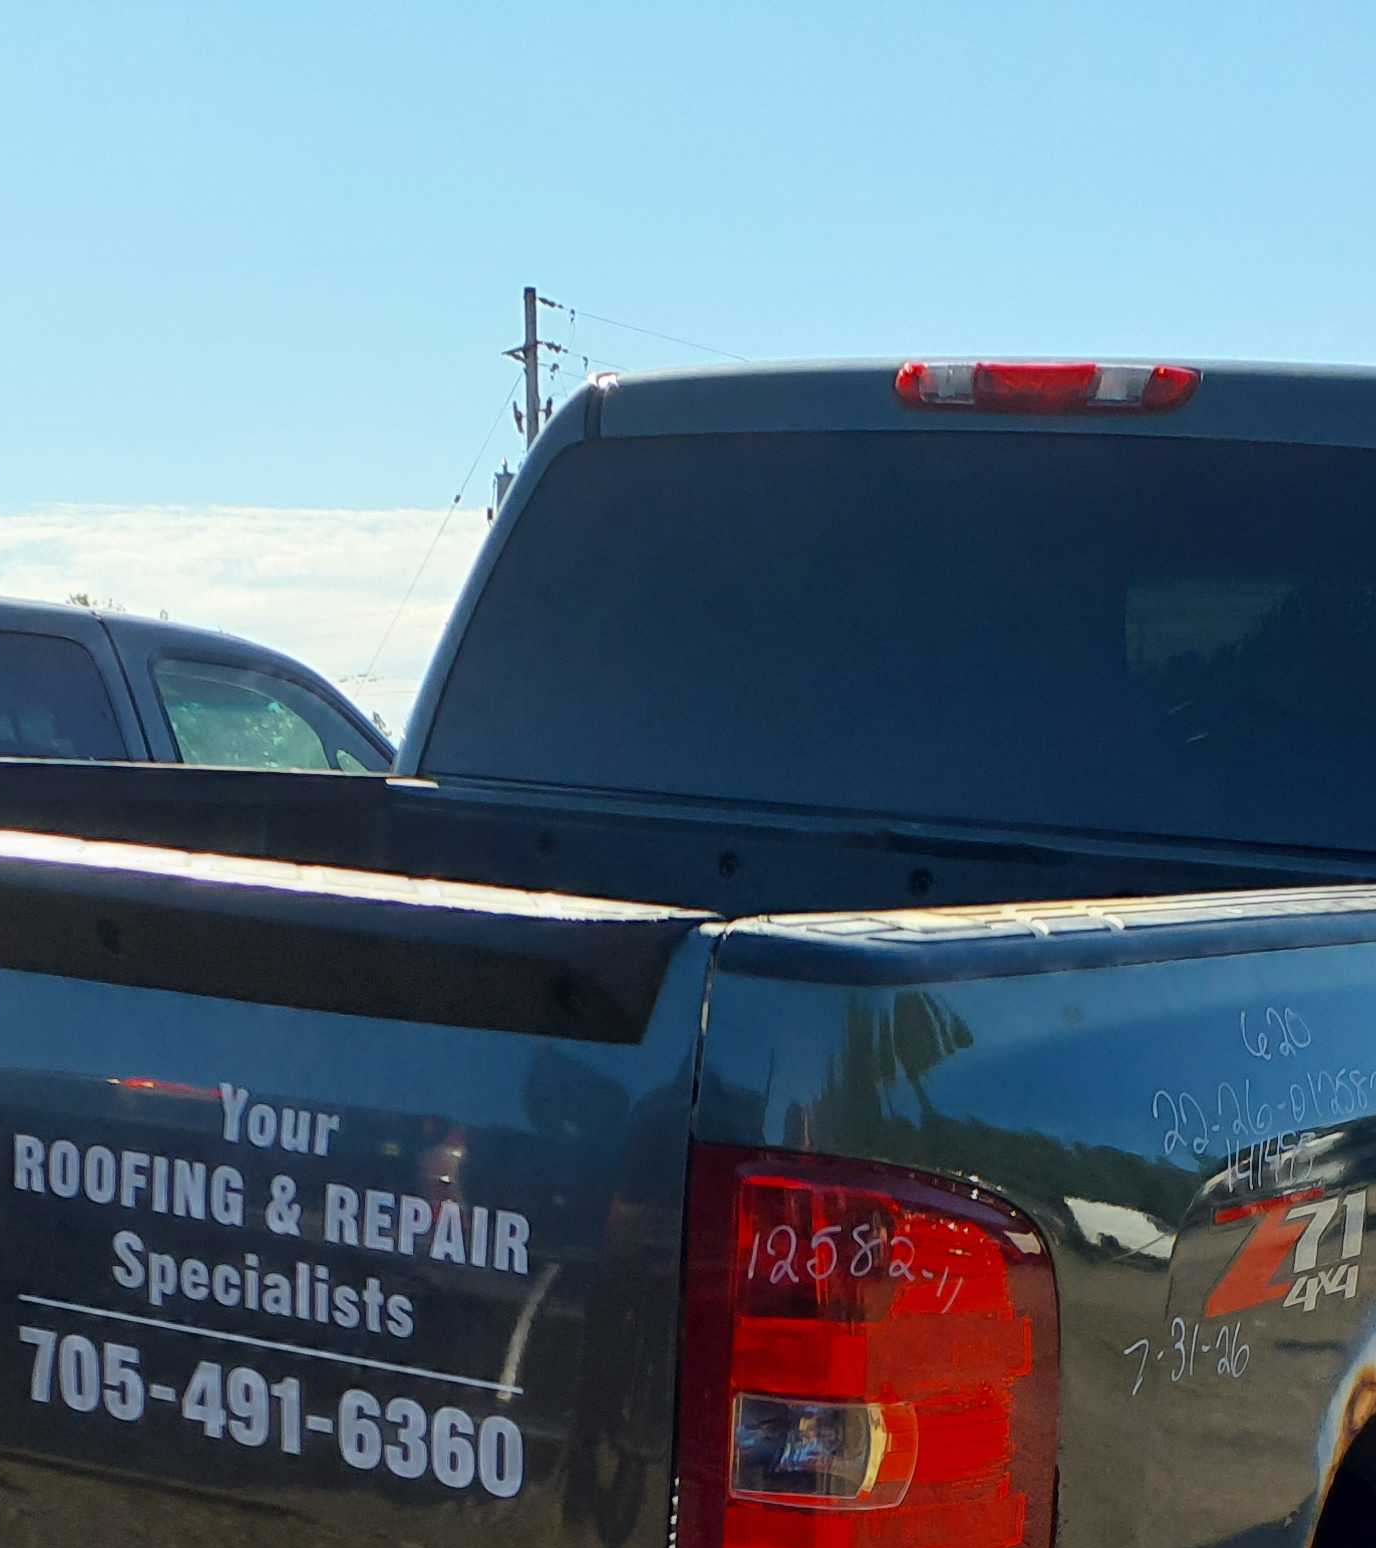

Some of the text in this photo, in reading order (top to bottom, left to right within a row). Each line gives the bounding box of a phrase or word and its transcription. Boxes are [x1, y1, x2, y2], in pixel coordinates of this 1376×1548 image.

[1240, 1007, 1312, 1062] 620
[219, 1082, 341, 1158] Your
[12, 1134, 530, 1275] ROOFING & REPAIR
[1204, 1186, 1367, 1319] Z71
[112, 1231, 413, 1339] Specialists
[747, 1223, 964, 1314] 12582-11
[19, 1326, 524, 1497] 705-491-6360
